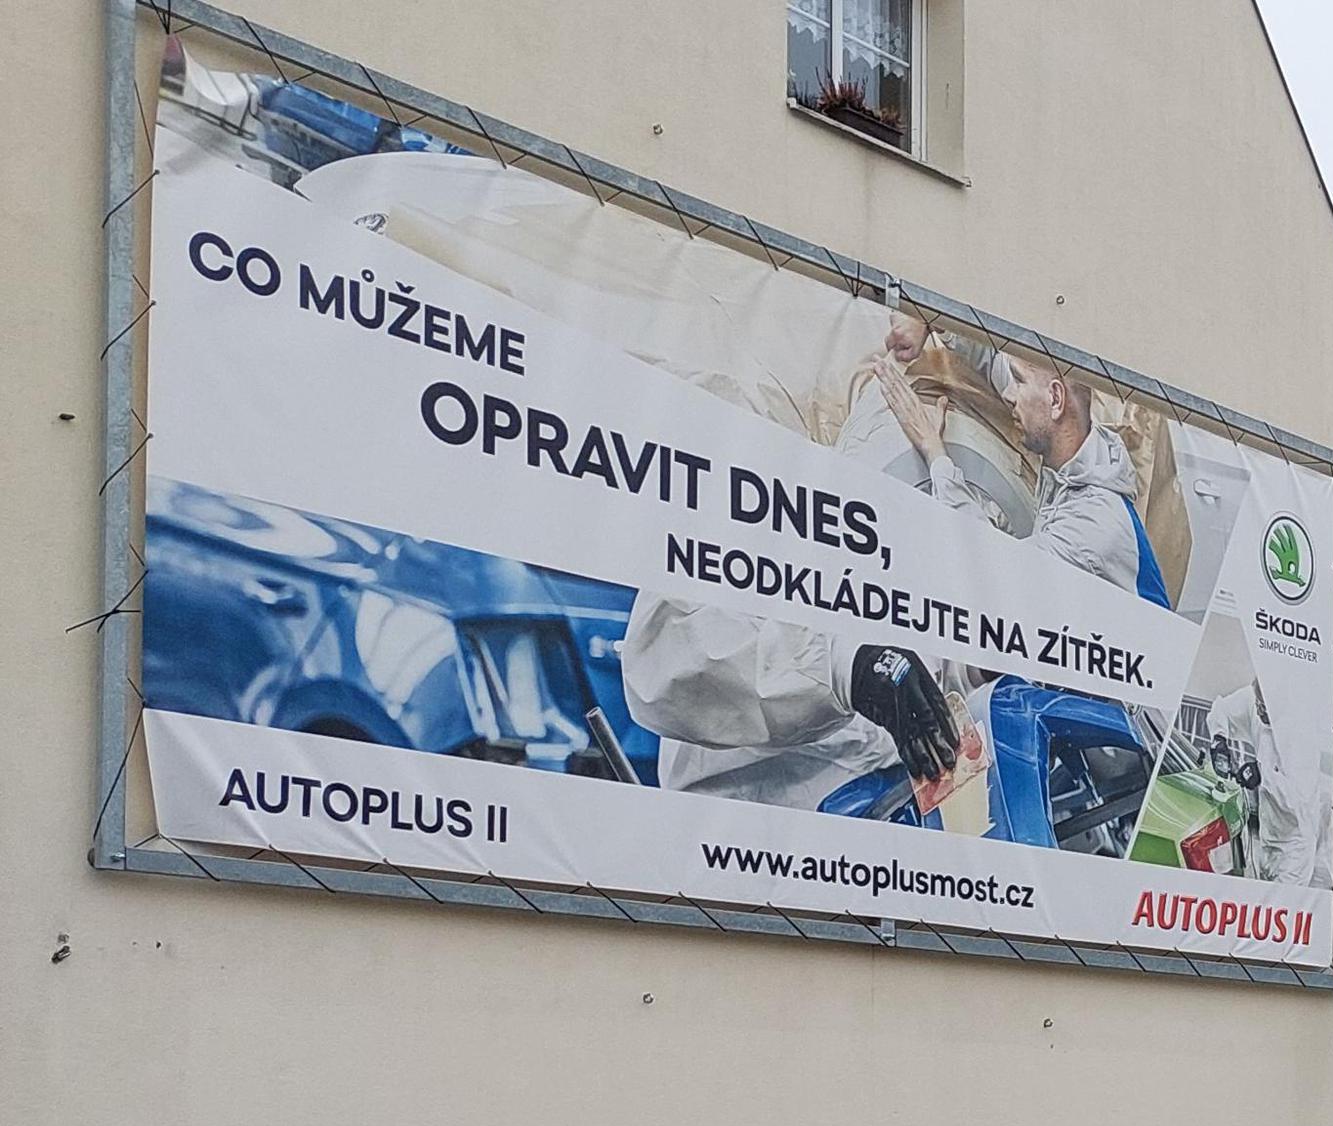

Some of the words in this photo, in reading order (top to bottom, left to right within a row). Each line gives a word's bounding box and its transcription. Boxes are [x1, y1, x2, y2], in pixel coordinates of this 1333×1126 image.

[189, 232, 281, 297] CO
[300, 264, 525, 376] MŮŽEME
[420, 381, 712, 511] OPRAVIT
[730, 466, 891, 571] DNES,
[667, 533, 970, 645] NEODKLÁDEJTE
[979, 613, 1029, 659] NA
[1037, 624, 1153, 689] ZÍTŘEK.
[1255, 608, 1321, 645] ŠKODA
[1259, 637, 1288, 654] SIMPLY
[1288, 646, 1318, 663] CLEVER
[218, 768, 473, 838] AUTOPLUS
[487, 804, 508, 843] II
[701, 843, 1034, 908] www.autoplusmost.cz
[1131, 890, 1289, 943] AUTOPLUS
[1293, 911, 1313, 946] II
